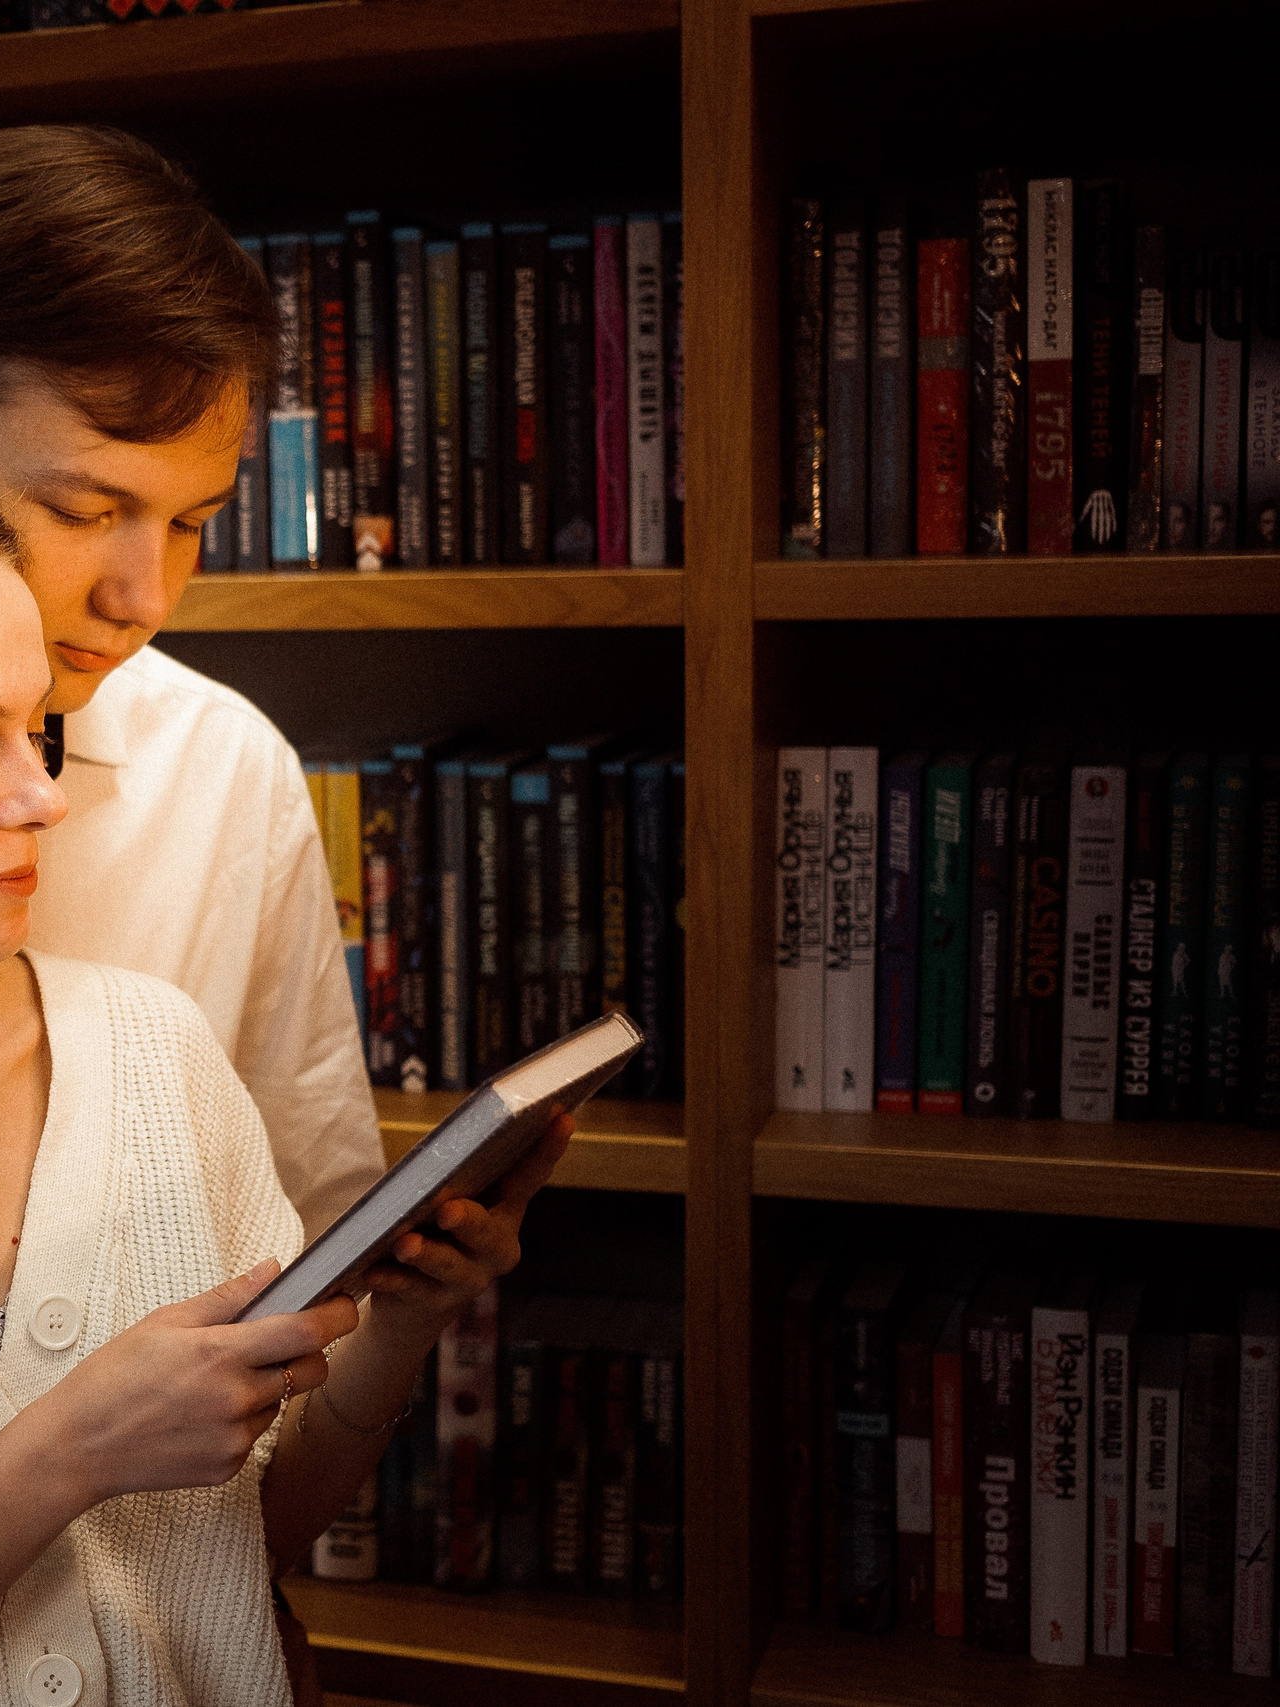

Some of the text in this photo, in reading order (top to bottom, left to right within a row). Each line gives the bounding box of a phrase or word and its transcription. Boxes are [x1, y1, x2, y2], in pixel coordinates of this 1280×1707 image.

[981, 193, 1019, 279] 1795
[1042, 190, 1059, 351] НИКЛАС НАТТ-О-ДАГ
[399, 275, 415, 369] СНЕЖНАЯ
[513, 267, 536, 404] БЛЕДНОЛИЦАЯ
[833, 231, 859, 361] КИСЛОРОД
[876, 228, 902, 358] КИСЛОРОД
[322, 300, 346, 443] КУЗНЕЧИК
[637, 350, 659, 444] ДЫШАТЬ
[1090, 317, 1112, 459] ТЕНИ ТЕНЕЙ
[398, 376, 414, 467] ДЕВОЧКА
[1034, 390, 1066, 482] 1795
[1174, 360, 1191, 492] ВНУТРИ УБИЙЦЫ
[1213, 358, 1230, 491] ВНУТРИ УБИЙЦЫ
[1252, 395, 1267, 468] ТЕМНОТЕ
[477, 806, 496, 899] МЕРЦАНИЕ
[778, 768, 806, 969] Мария Орунья
[801, 810, 824, 963] Пристанище
[828, 770, 857, 972] Мария Орунья
[851, 812, 875, 966] Пристанище
[1261, 801, 1278, 889] НЕРВНЫЙ
[479, 903, 496, 926] ВО
[1027, 856, 1063, 998] CASINO
[1126, 878, 1156, 972] СТАЛКЕР
[978, 909, 1000, 1068] СВЯЩЕННАЯ ЛОЖЬ
[1071, 932, 1091, 998] ПАРНИ
[1092, 913, 1113, 1011] СЛАВНЫЕ
[1126, 979, 1152, 1009] ИЗ
[1122, 1015, 1150, 1096] СУРРЕЯ
[1161, 1023, 1176, 1075] НИТА
[1177, 1013, 1195, 1084] ПРОУЗ
[1208, 1024, 1224, 1078] НИТА
[1224, 1015, 1242, 1086] ПРОУЗ
[1034, 1339, 1062, 1495] В доме лжи
[1055, 1333, 1087, 1500] Йэн Рэнкин
[1101, 1347, 1124, 1460] СОДЗИ СИМАДА
[1146, 1396, 1167, 1490] СОДЗИ СИМАДА
[979, 1454, 1016, 1600] Провал
[1239, 1487, 1253, 1550] КАЖДЫЙ
[1250, 1570, 1264, 1643] Стивенсон
